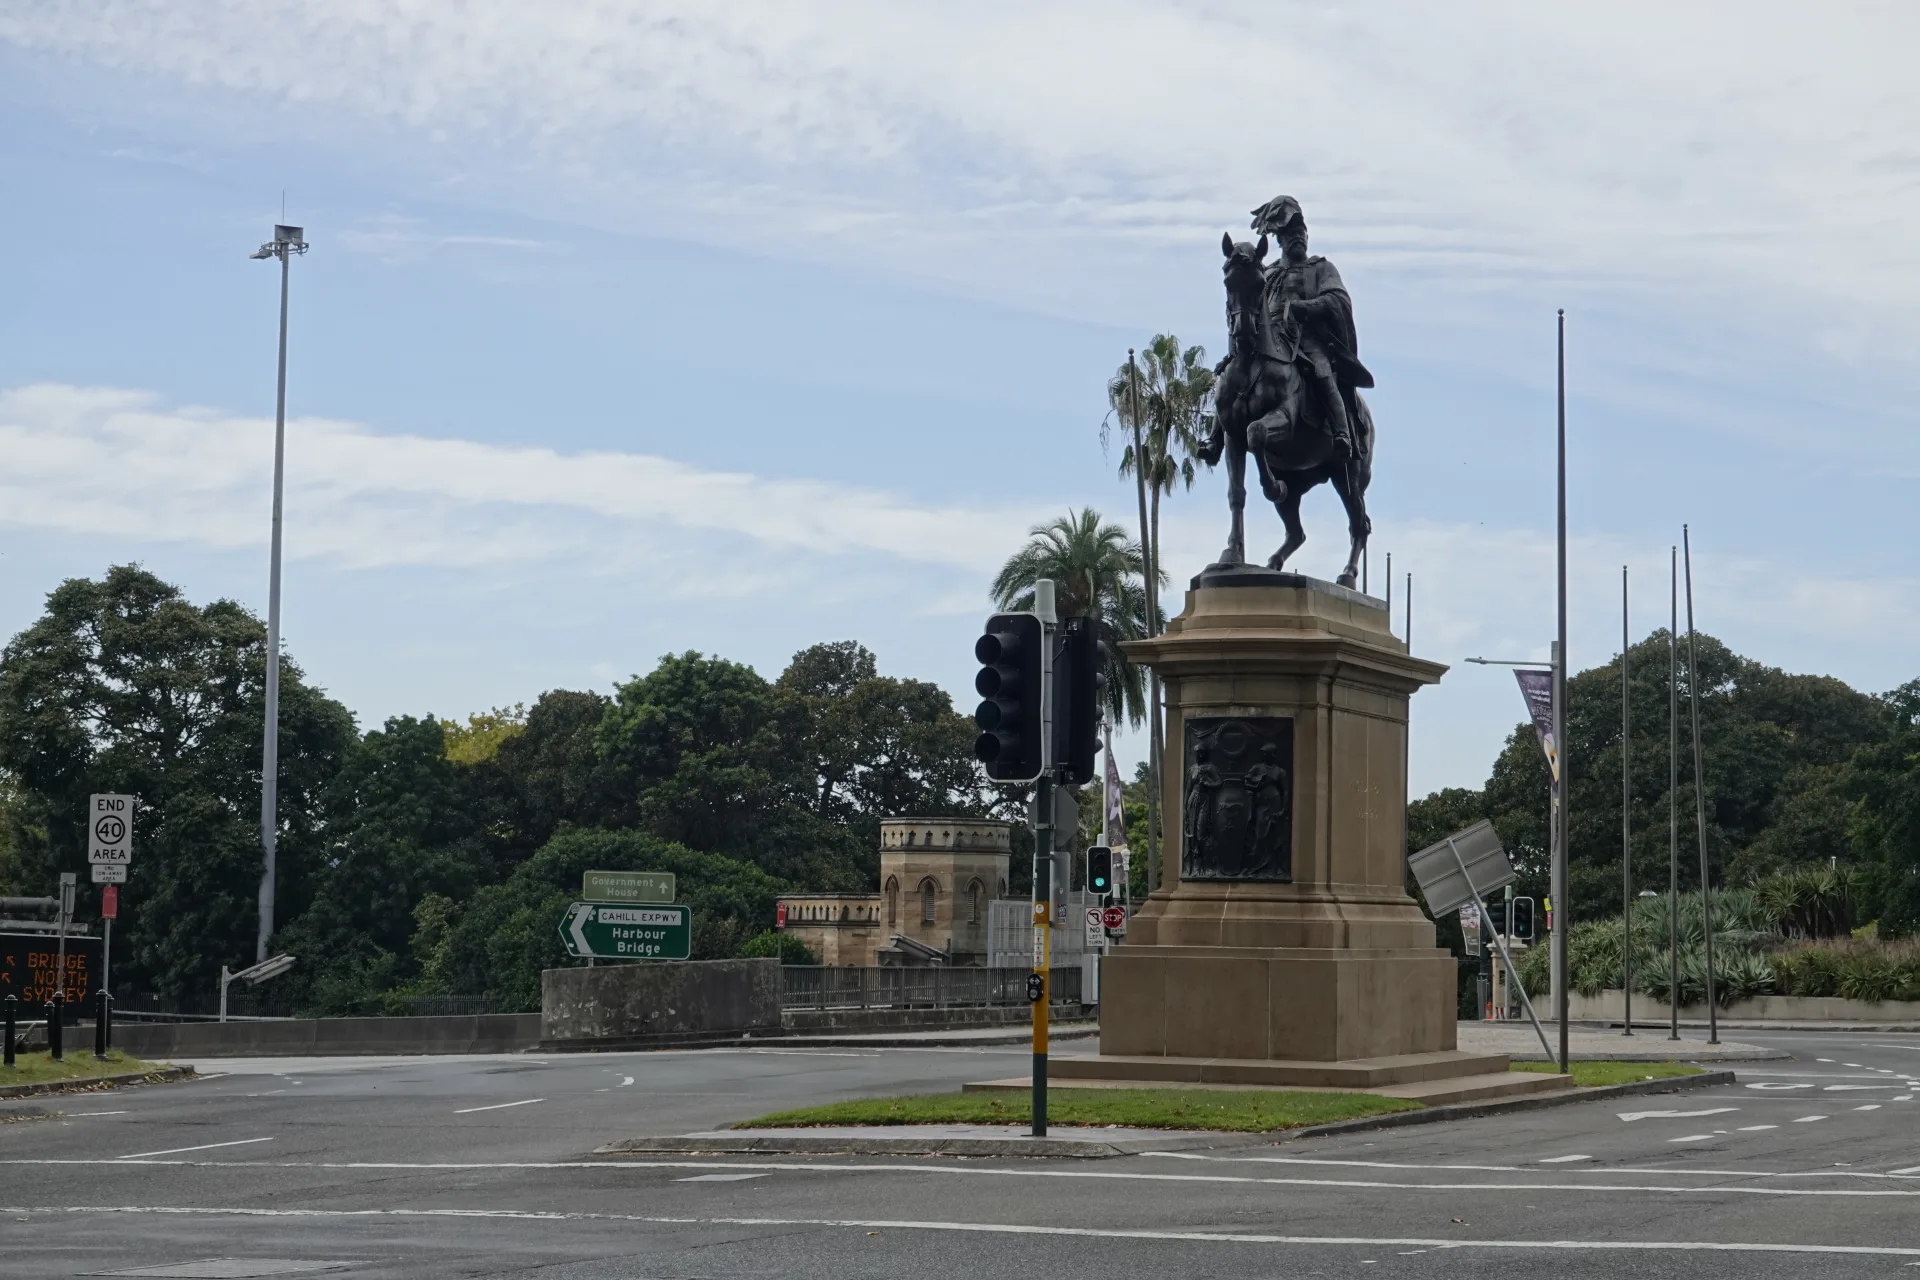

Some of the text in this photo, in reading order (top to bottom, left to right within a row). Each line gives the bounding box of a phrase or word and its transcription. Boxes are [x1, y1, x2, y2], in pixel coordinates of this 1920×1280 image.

[97, 799, 125, 811] END
[98, 822, 122, 838] 40
[93, 848, 127, 860] AREA
[591, 876, 654, 887] Government
[607, 887, 638, 897] House
[601, 912, 678, 923] CAHILL EXPWY
[612, 927, 666, 940] Harbour
[617, 941, 661, 956] Bridge
[27, 952, 87, 970] BRIDGE
[34, 969, 88, 987] NORTH
[23, 985, 87, 1003] SYDEY
